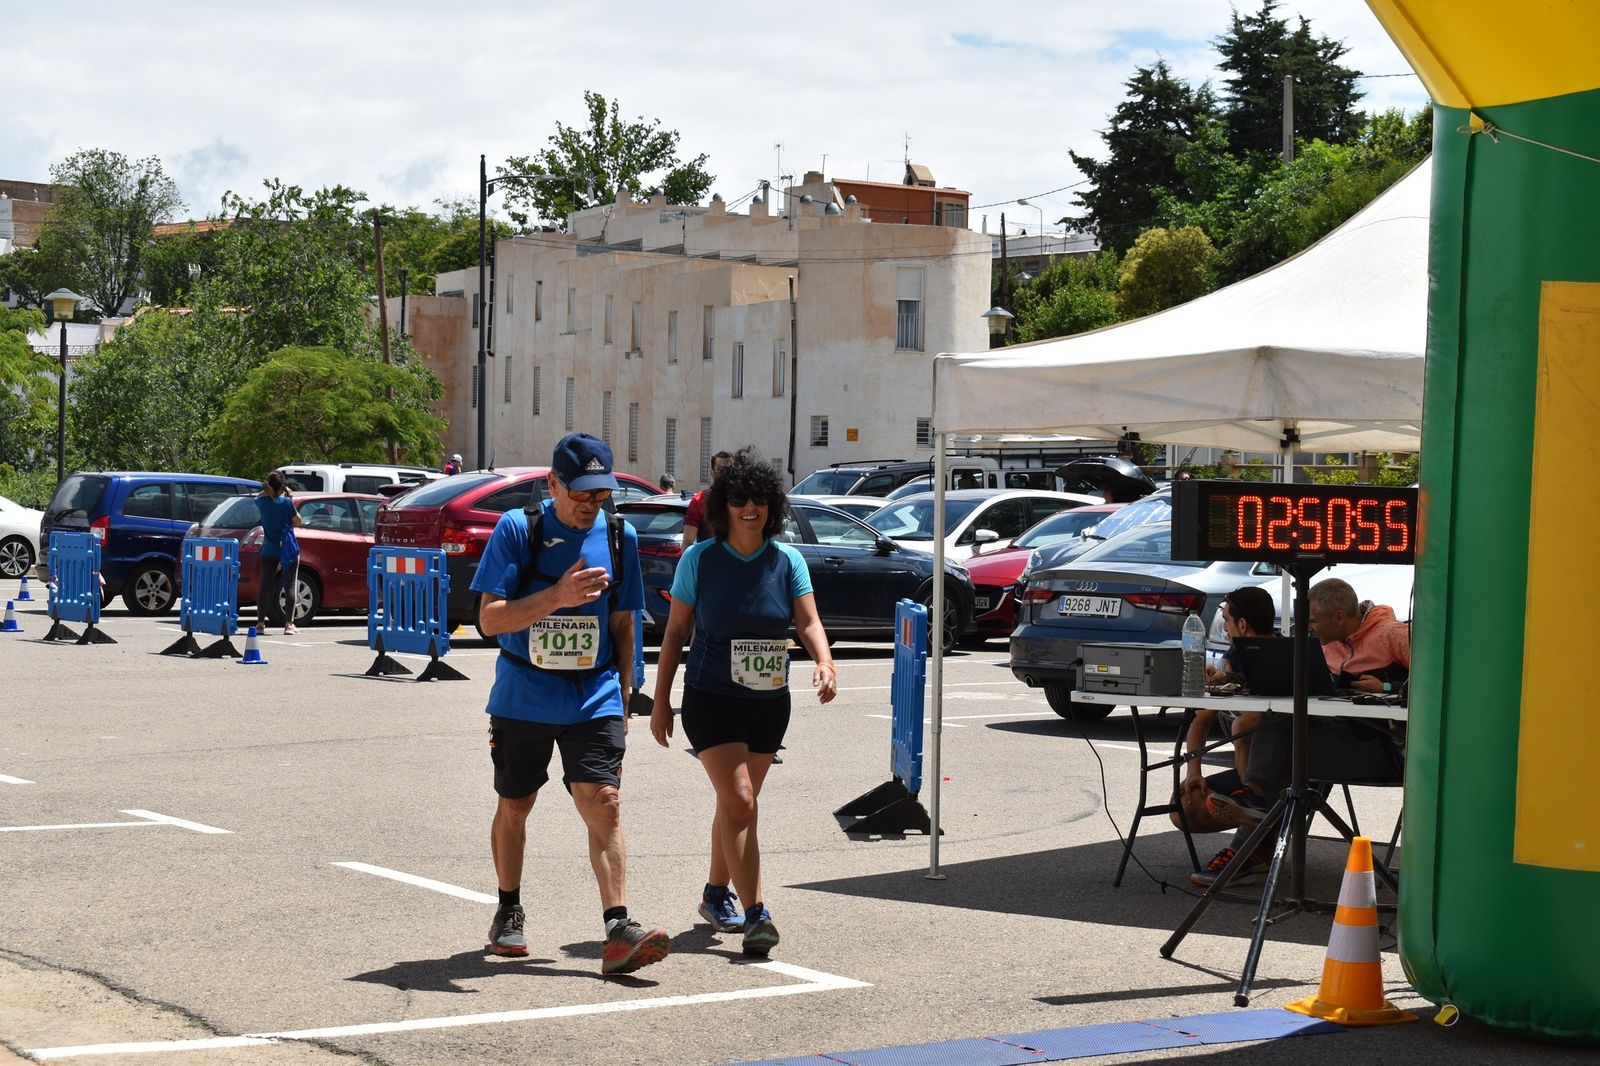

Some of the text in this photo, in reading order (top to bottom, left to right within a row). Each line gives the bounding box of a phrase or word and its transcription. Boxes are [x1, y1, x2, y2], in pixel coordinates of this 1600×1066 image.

[1236, 494, 1408, 552] 02:50:55
[1064, 599, 1118, 614] 9268 JNT
[538, 632, 593, 650] 1013
[741, 656, 783, 672] 1045
